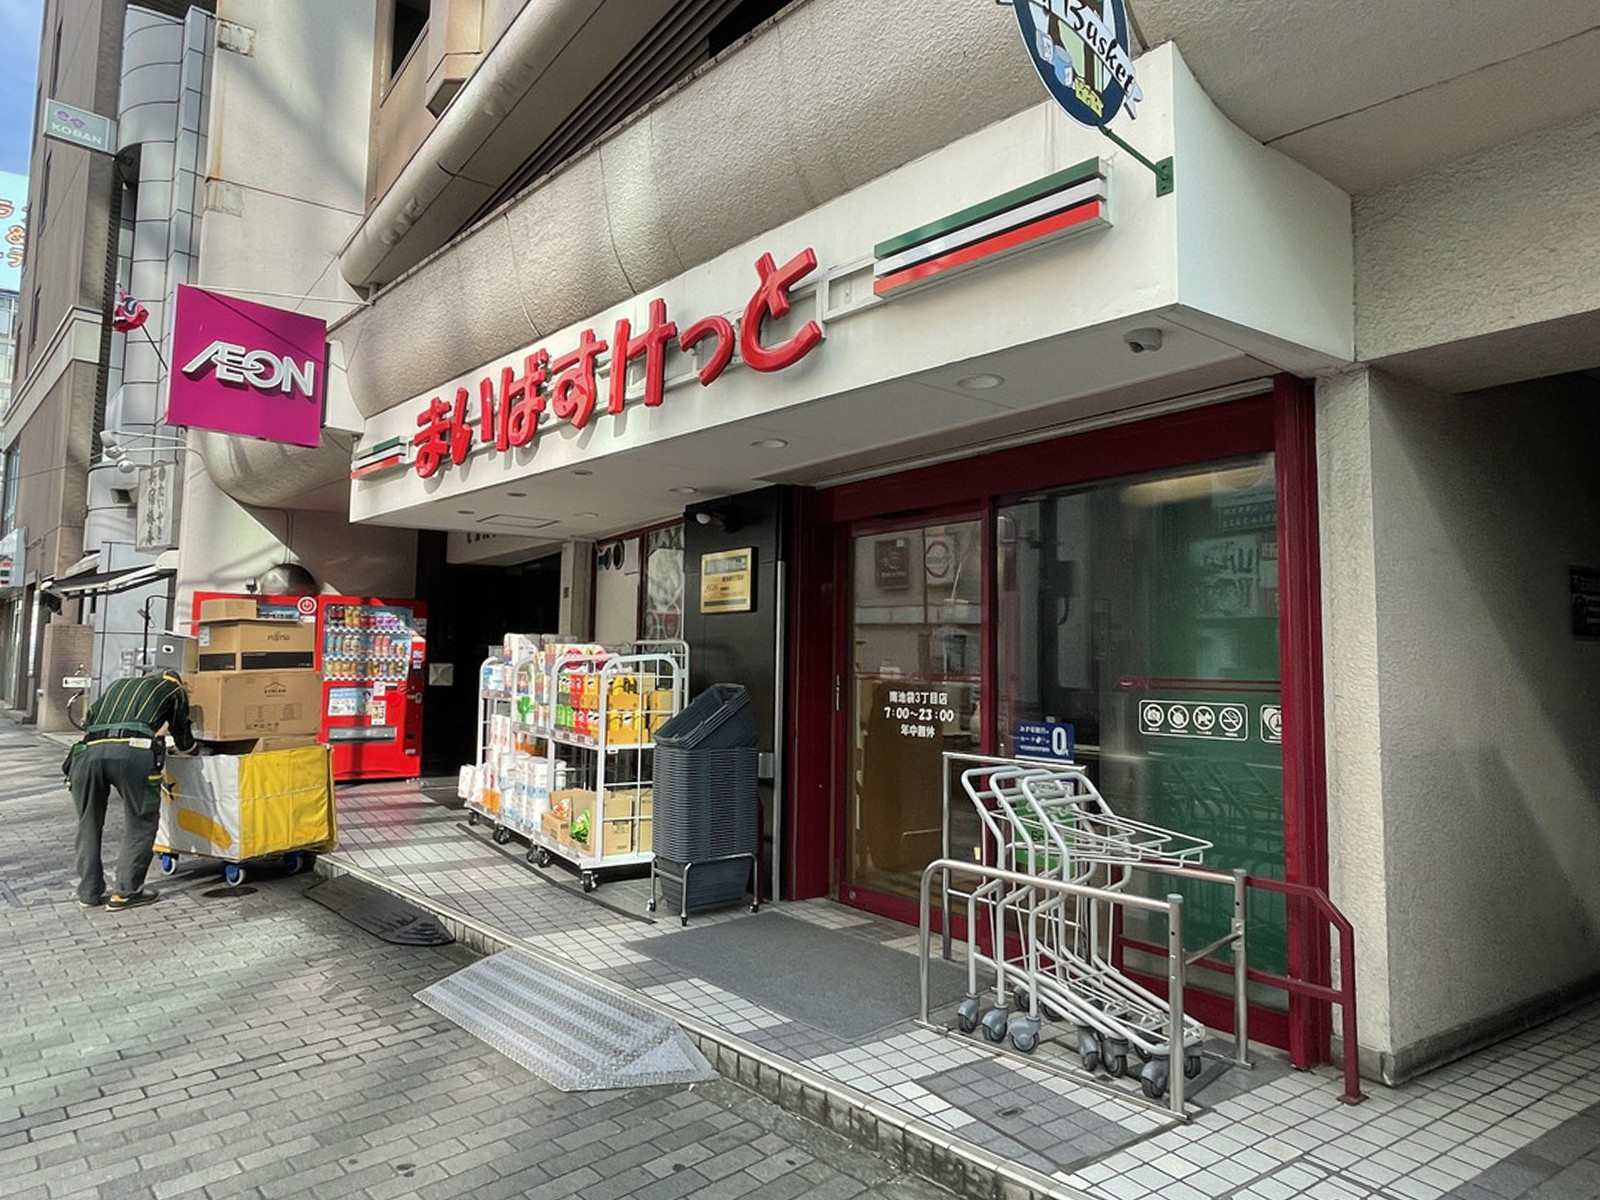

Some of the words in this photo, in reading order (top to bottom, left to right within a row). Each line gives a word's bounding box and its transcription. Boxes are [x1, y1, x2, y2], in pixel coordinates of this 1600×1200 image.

[1064, 0, 1134, 93] Basket
[51, 122, 103, 145] KOBAN
[182, 340, 315, 397] AEON
[414, 247, 824, 478] まいばすけっと
